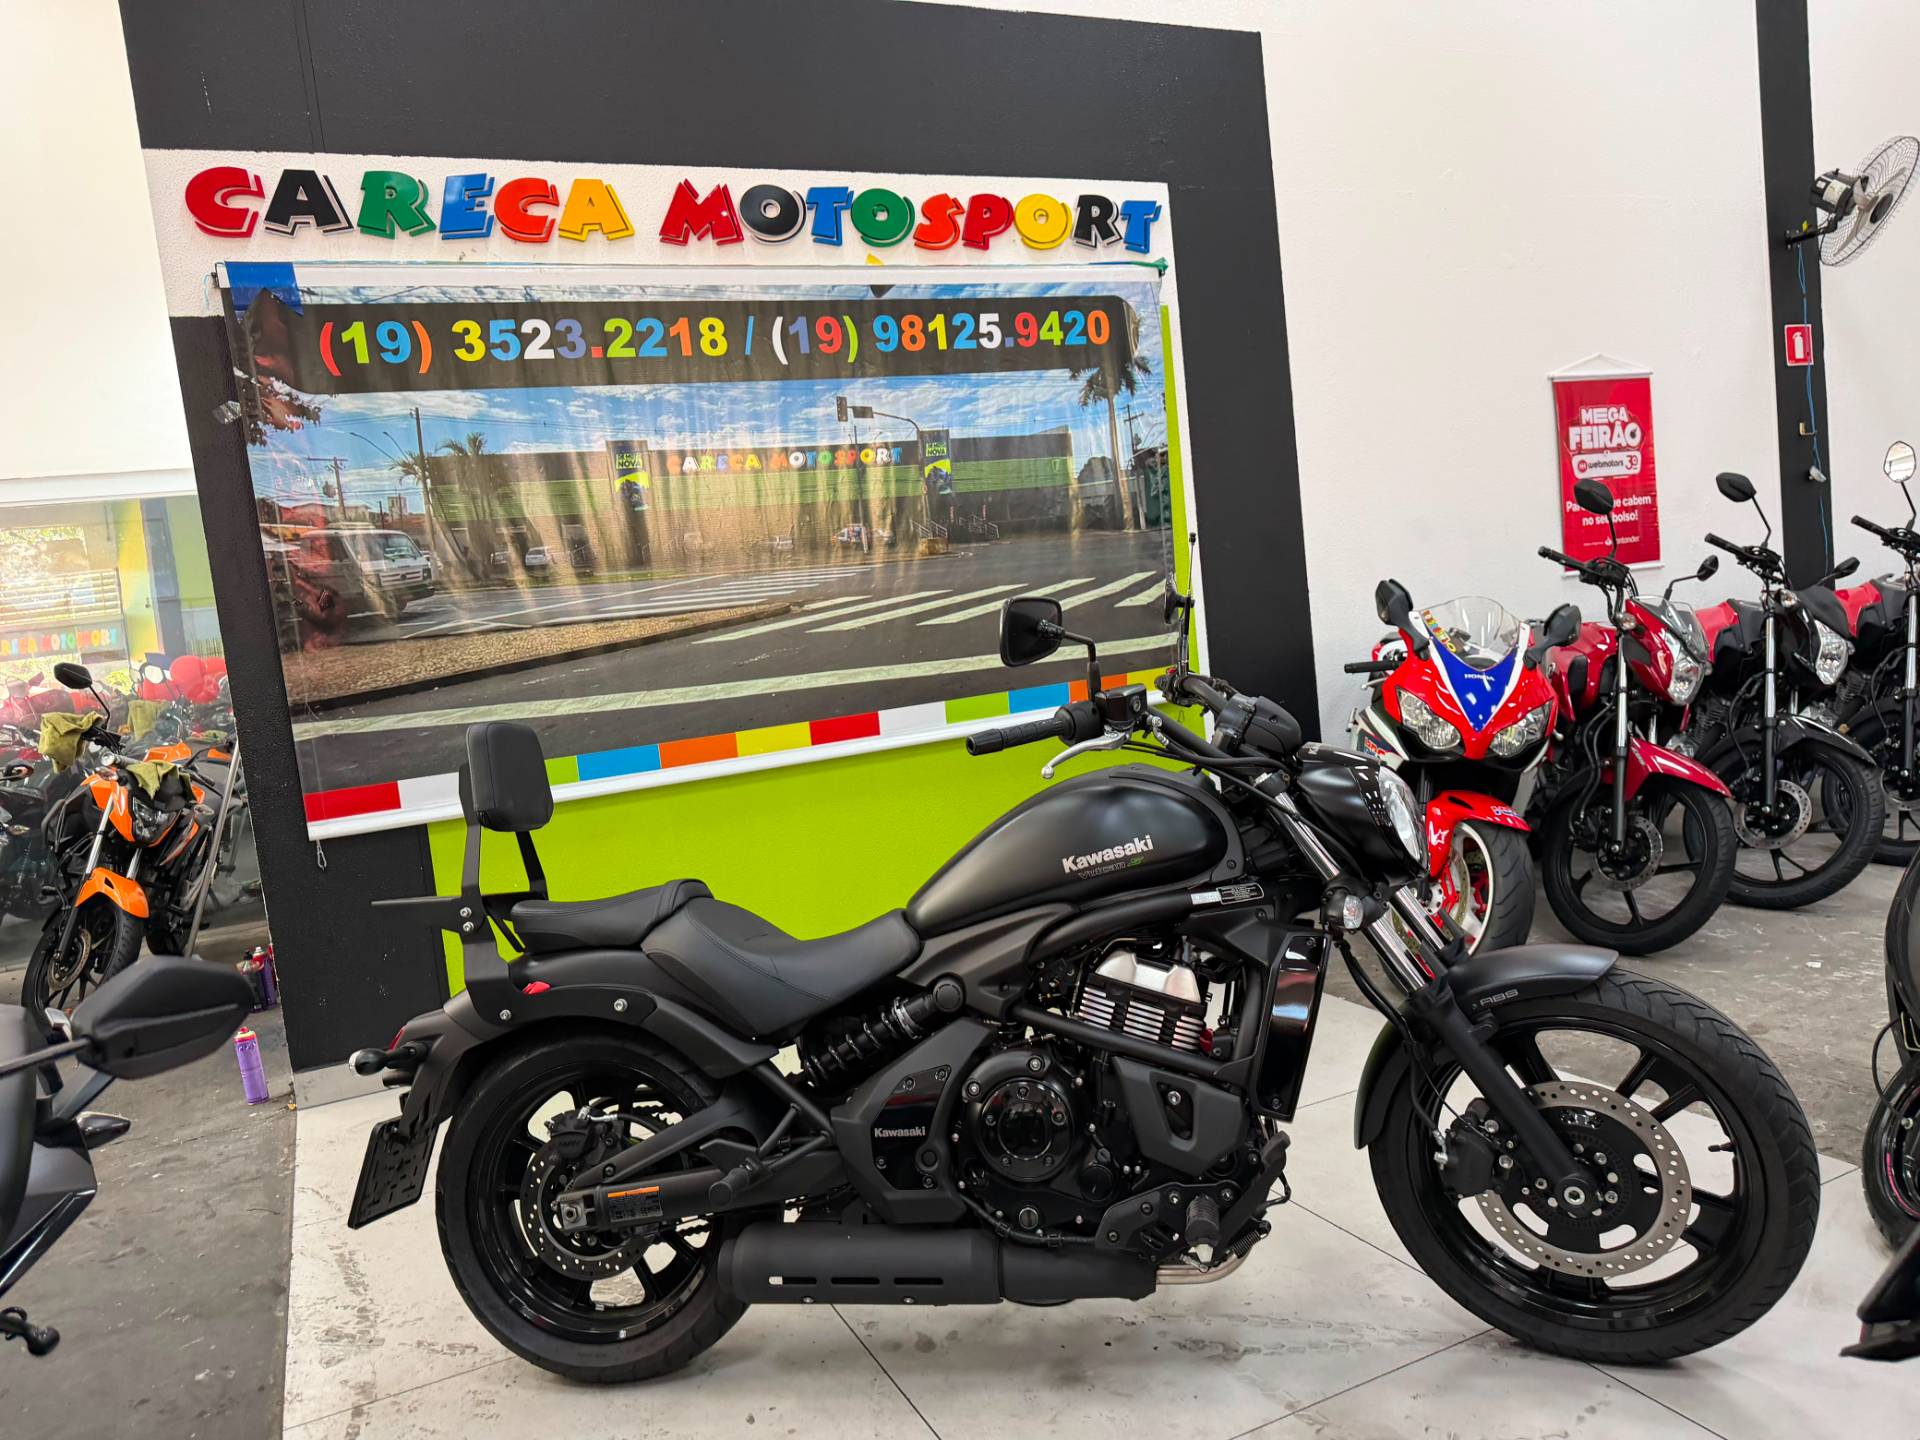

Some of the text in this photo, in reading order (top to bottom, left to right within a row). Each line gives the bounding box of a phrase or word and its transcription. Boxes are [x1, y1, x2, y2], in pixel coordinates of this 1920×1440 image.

[185, 166, 1162, 254] CARECA MOTOSPORT
[319, 320, 432, 376] (19)
[451, 316, 728, 362] 3523.2218
[772, 315, 859, 365] (19)
[872, 310, 1111, 353] 98125.9420
[1581, 406, 1628, 424] MEGA
[1568, 420, 1641, 451] FEIRÃO
[666, 447, 903, 475] CARECA MOTOSPORT
[1588, 459, 1624, 469] webmotors
[1622, 495, 1651, 506] cabem
[1582, 516, 1594, 527] no
[1612, 509, 1638, 523] bolso!
[1463, 673, 1495, 681] HONDA
[1062, 834, 1154, 874] Kawasaki
[874, 1126, 926, 1138] Kawasaki
